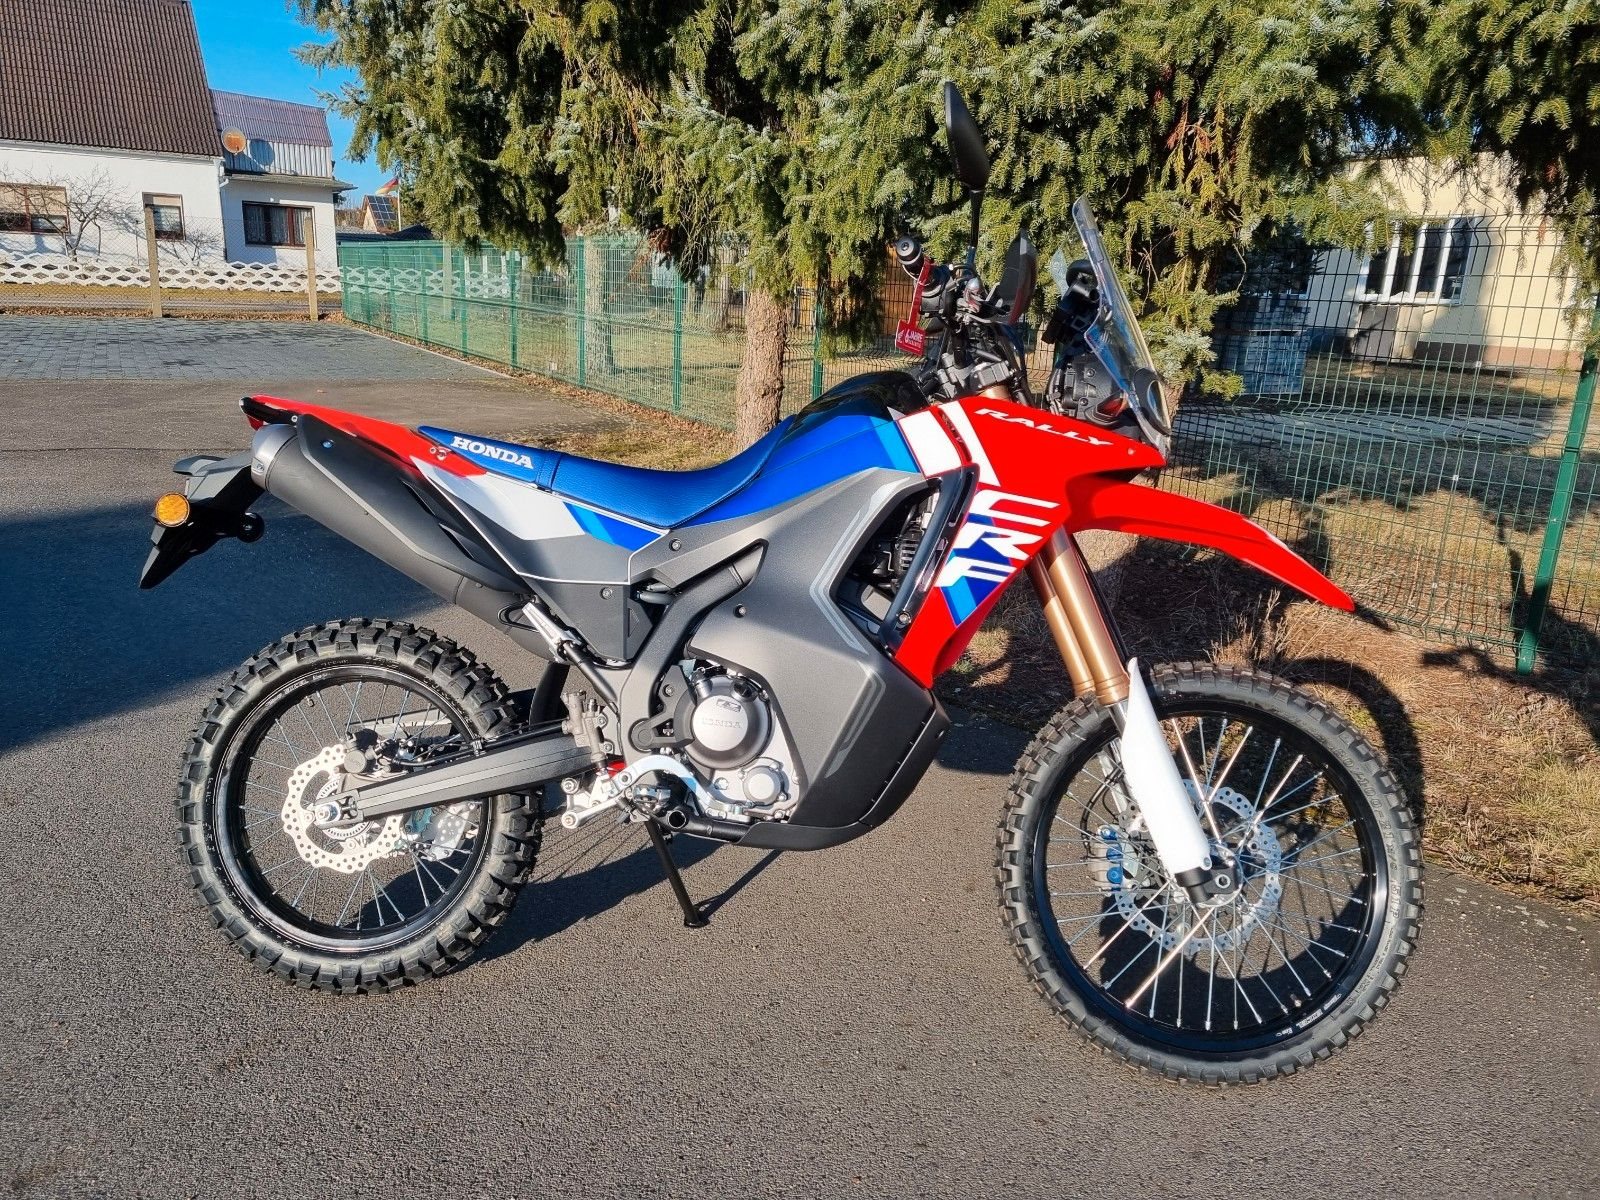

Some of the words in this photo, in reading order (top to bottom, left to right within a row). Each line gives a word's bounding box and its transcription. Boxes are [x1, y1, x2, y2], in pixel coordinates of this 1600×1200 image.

[974, 408, 1114, 445] RALLY
[450, 436, 534, 469] HONDA
[934, 489, 1060, 587] CRF
[702, 717, 742, 729] HONDA
